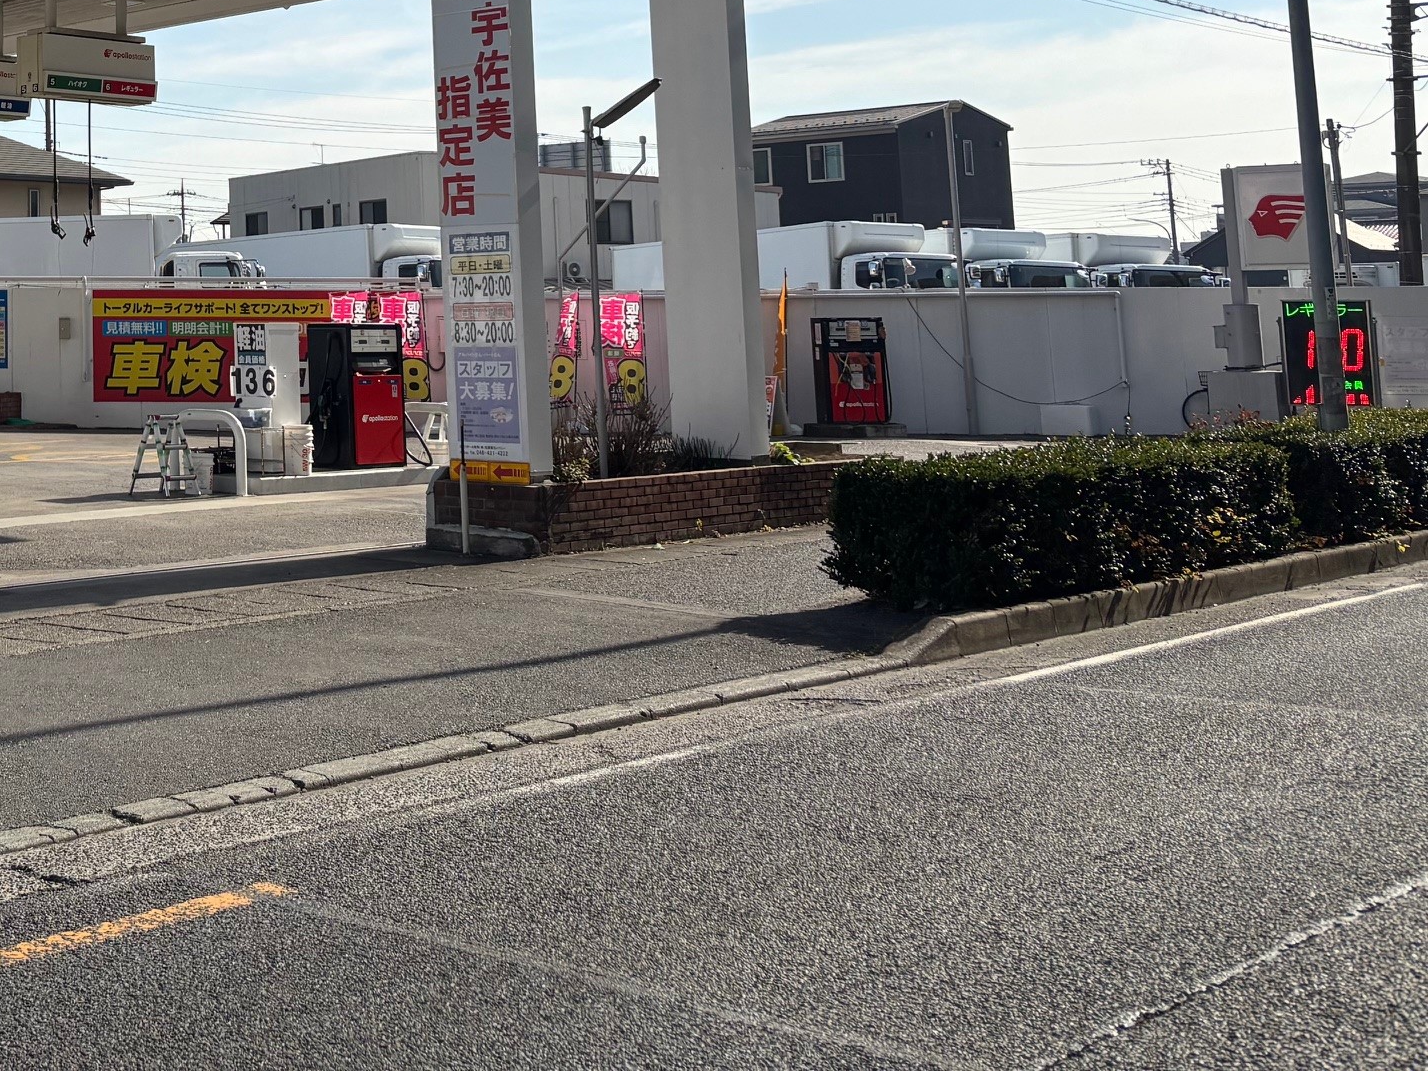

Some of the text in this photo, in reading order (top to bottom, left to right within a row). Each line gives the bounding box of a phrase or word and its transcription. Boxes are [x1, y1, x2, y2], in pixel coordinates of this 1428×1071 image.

[112, 51, 152, 61] apollostation
[471, 1, 512, 142] 宇佐美
[68, 80, 88, 88] ハイオク
[121, 85, 144, 93] レギュラー
[437, 75, 476, 216] 指定店
[452, 235, 507, 252] 営業時間
[457, 259, 504, 271] 平日・土曜
[452, 275, 511, 298] 7:30~20:00
[103, 302, 324, 315] トータルカーライフサポート! 全てワンストップ!
[1285, 302, 1363, 317] レギラー
[106, 321, 163, 335] 見積無料!!
[172, 321, 229, 335] 明朗会計!!
[454, 322, 514, 344] 8:30~20:00
[237, 324, 266, 352] 軽油
[1307, 328, 1364, 371] 10
[238, 354, 266, 364] 会員価格
[105, 340, 226, 396] 車検
[458, 362, 511, 377] スタッフ
[231, 367, 276, 397] 136
[459, 381, 515, 401] 大募集!
[368, 414, 399, 423] apollostation
